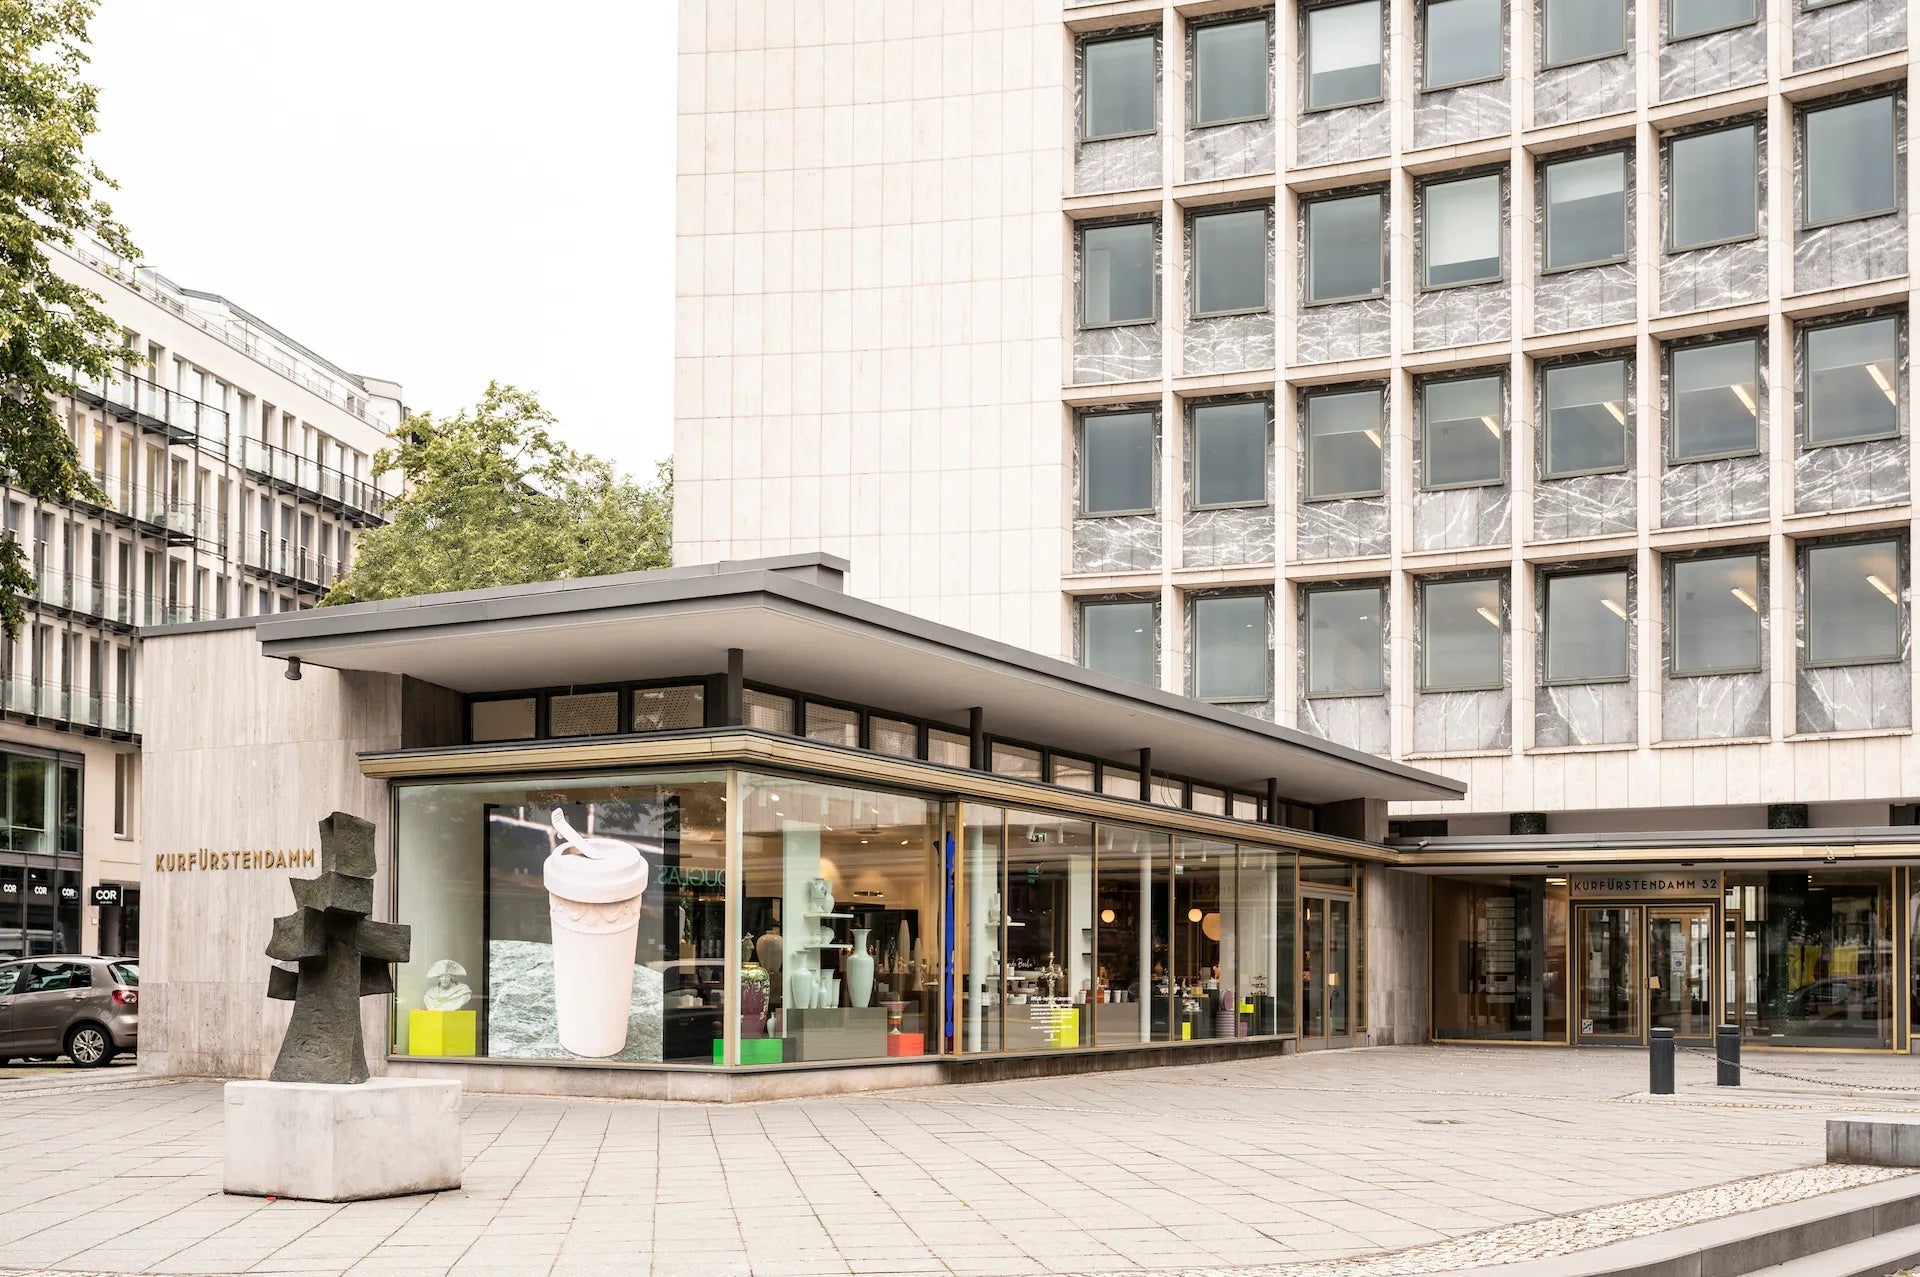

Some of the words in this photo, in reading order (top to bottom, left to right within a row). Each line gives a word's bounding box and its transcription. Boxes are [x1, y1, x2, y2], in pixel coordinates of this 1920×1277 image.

[155, 848, 315, 872] KURFÜRSTENDAMM
[3, 884, 17, 893] COR
[1574, 878, 1695, 891] KURFÜRSTENDAMM
[1702, 879, 1717, 889] 32
[34, 886, 47, 895] COR
[62, 888, 75, 897] COR
[95, 889, 117, 900] COR
